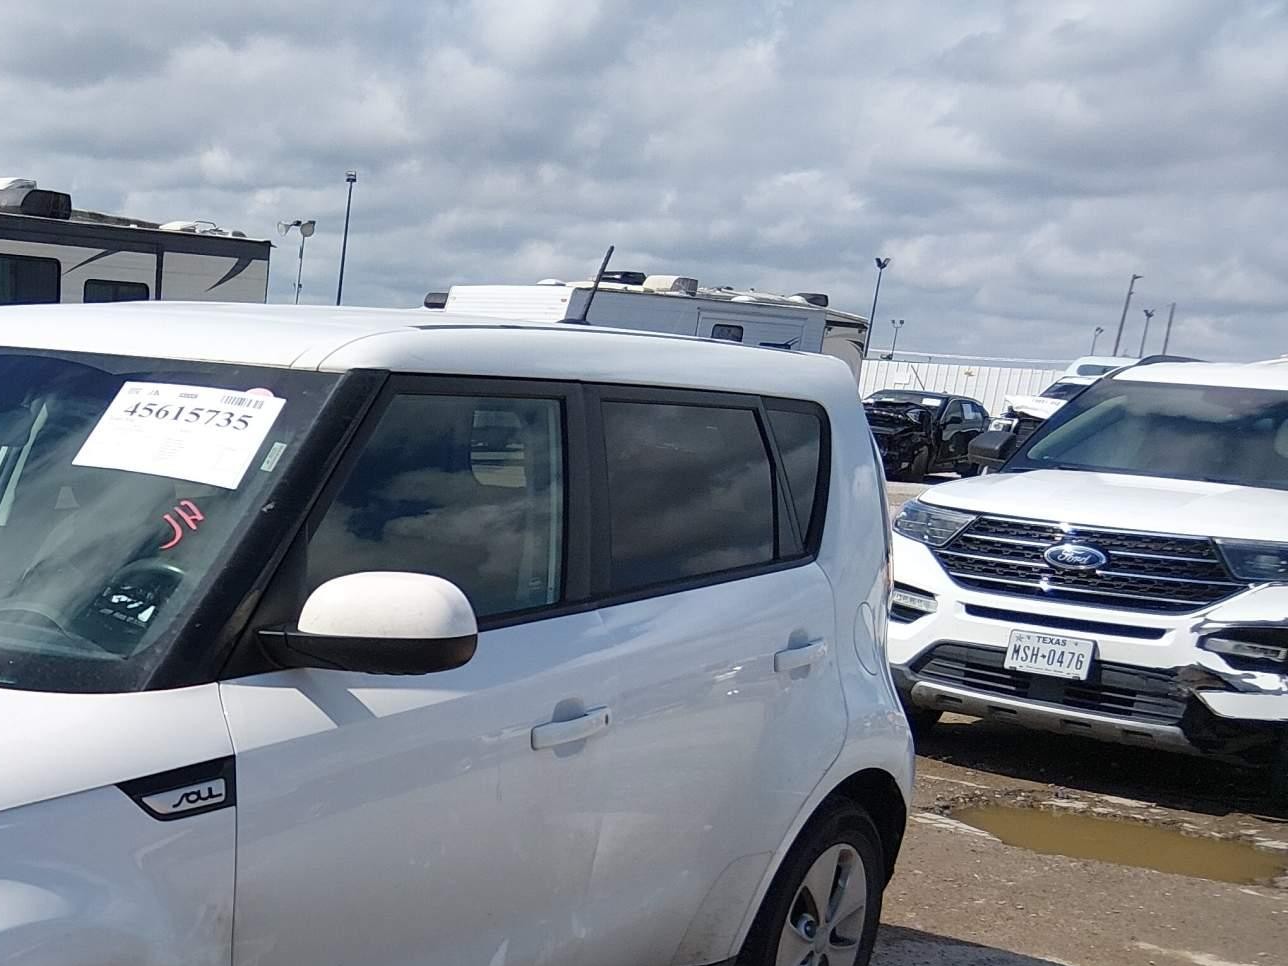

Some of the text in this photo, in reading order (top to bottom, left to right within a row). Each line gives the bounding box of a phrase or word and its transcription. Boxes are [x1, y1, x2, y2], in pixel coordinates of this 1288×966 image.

[123, 400, 253, 432] 45615735
[1057, 549, 1093, 565] Ford
[1036, 635, 1068, 648] TEXAS
